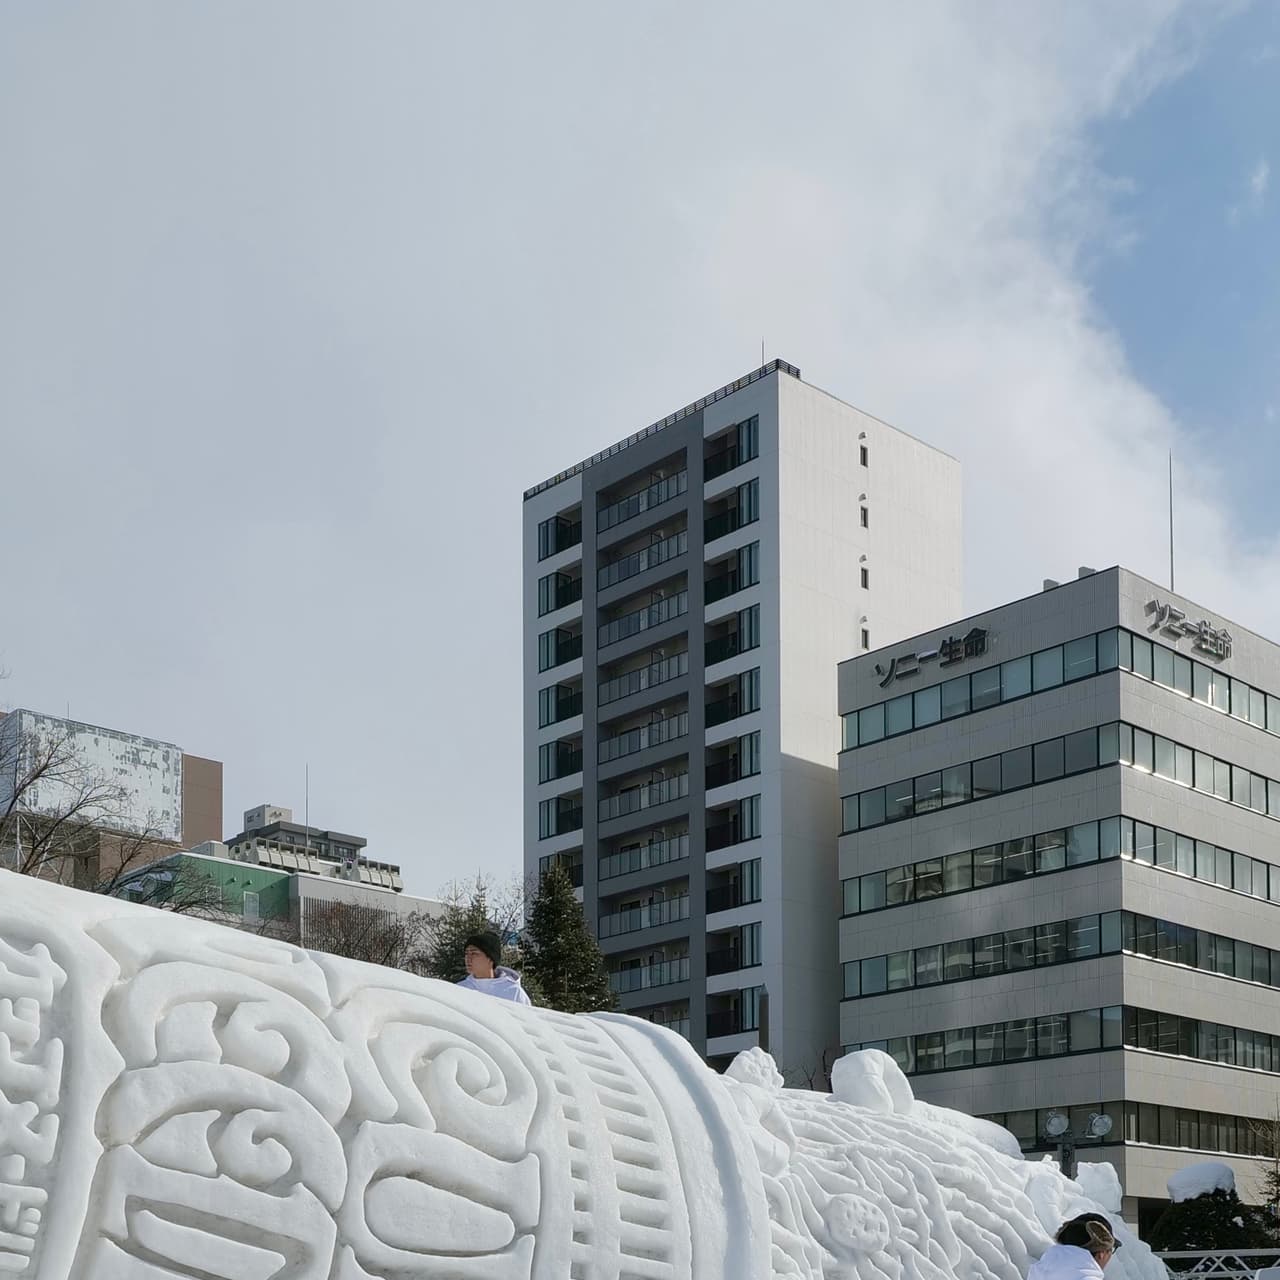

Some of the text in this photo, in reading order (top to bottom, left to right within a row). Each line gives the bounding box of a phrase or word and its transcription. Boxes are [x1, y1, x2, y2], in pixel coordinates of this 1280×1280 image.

[875, 626, 988, 688] ソニー生命
[1144, 599, 1233, 664] ソニー生命
